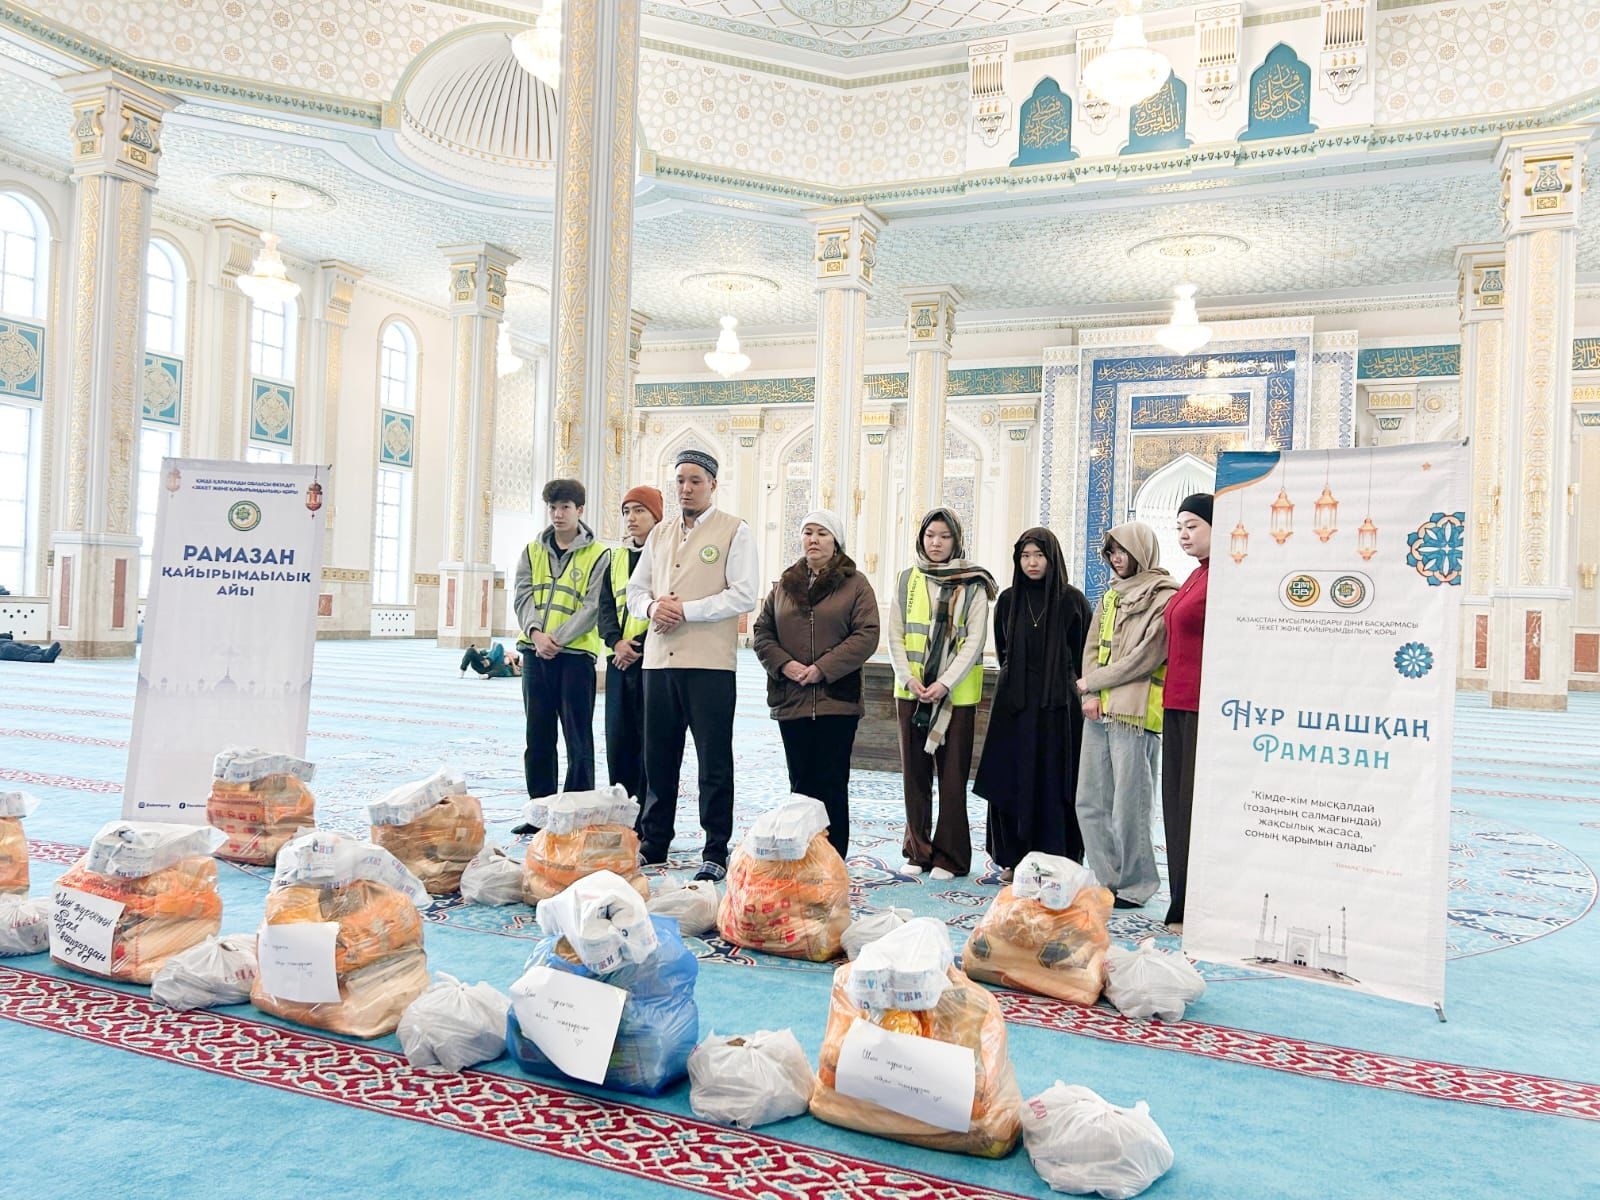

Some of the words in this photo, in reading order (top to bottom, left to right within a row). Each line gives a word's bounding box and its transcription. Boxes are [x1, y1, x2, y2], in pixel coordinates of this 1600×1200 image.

[183, 544, 295, 565] РАМАЗАН
[162, 565, 311, 583] ҚАЙЫРЫМДЫЛЫҚ
[216, 583, 254, 597] АЙЫ
[1243, 801, 1299, 818] (тозаңның
[1301, 810, 1382, 828] салмағындай)
[1311, 798, 1375, 814] мысқалдай
[1258, 818, 1314, 833] жақсылық
[1244, 829, 1279, 842] соның
[1281, 834, 1333, 848] қарымын
